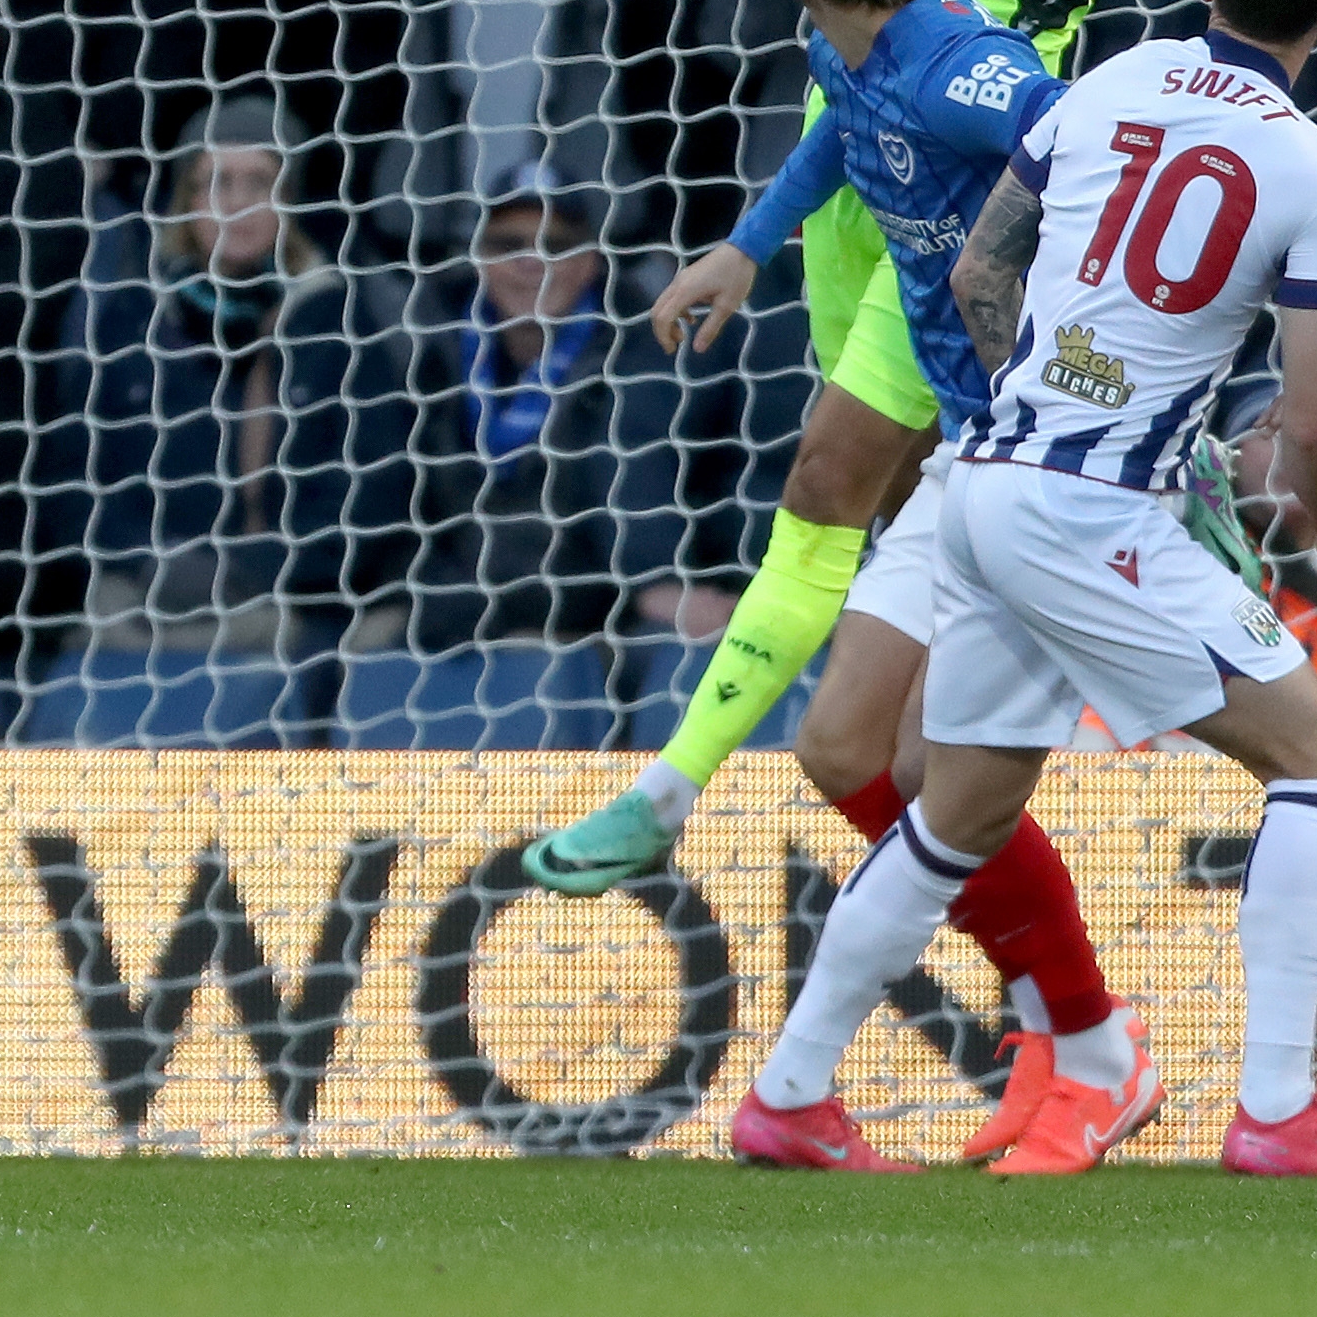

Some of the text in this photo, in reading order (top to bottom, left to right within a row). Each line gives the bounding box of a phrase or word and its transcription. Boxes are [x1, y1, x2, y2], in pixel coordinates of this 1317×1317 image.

[945, 54, 1011, 107] Bee
[1160, 67, 1300, 122] SWIFT
[939, 213, 961, 230] OF
[1077, 121, 1259, 315] 10
[1048, 364, 1119, 404] RICHES
[1057, 346, 1123, 384] MEGA
